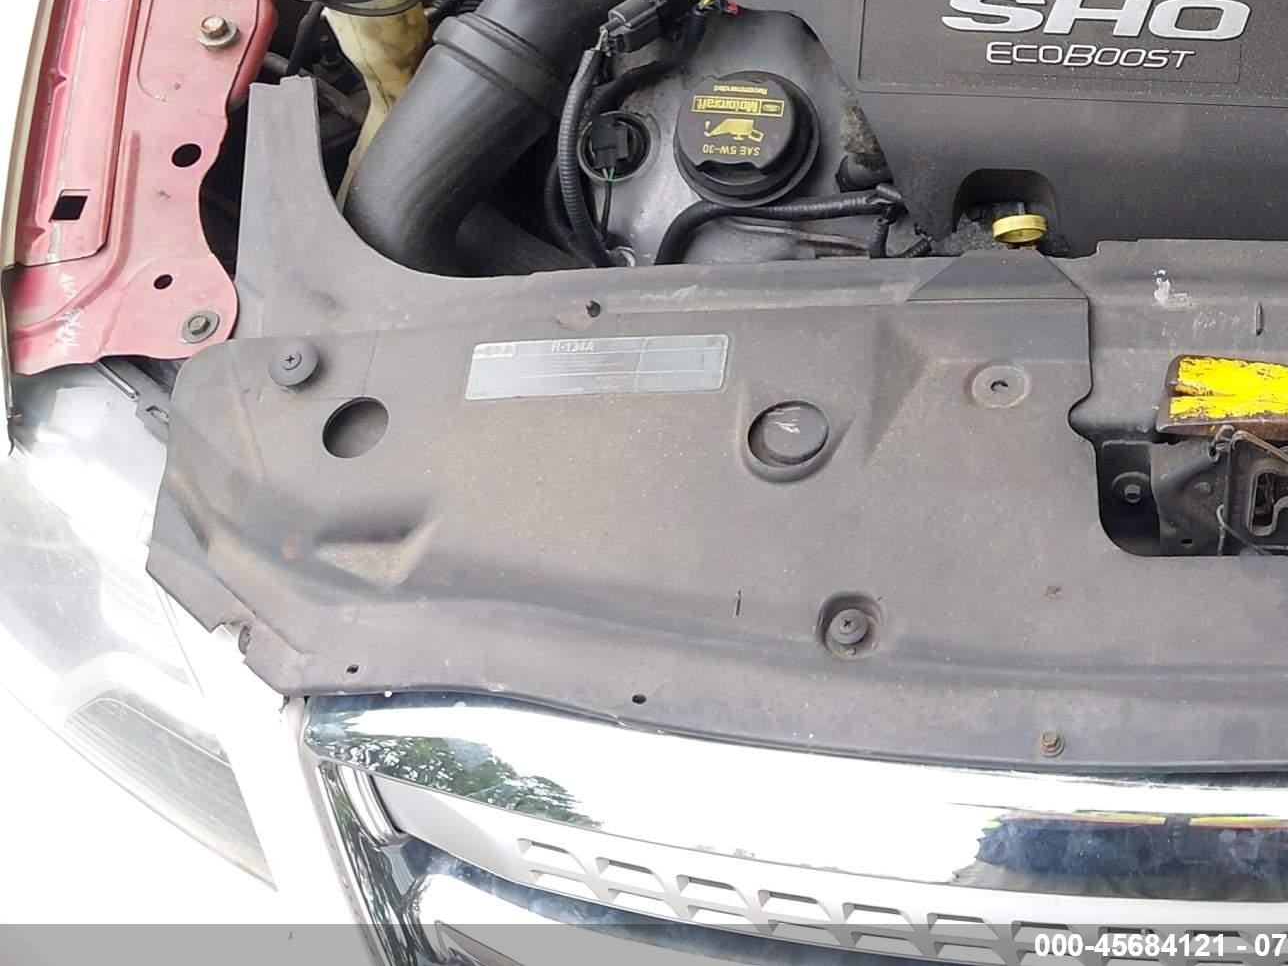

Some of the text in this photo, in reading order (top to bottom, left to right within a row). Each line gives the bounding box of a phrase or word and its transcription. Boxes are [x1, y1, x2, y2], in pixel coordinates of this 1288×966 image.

[713, 84, 768, 95] Recommended
[697, 98, 759, 113] Motorcraft
[702, 144, 761, 156] SAE 5W-30
[551, 342, 595, 352] R-134A
